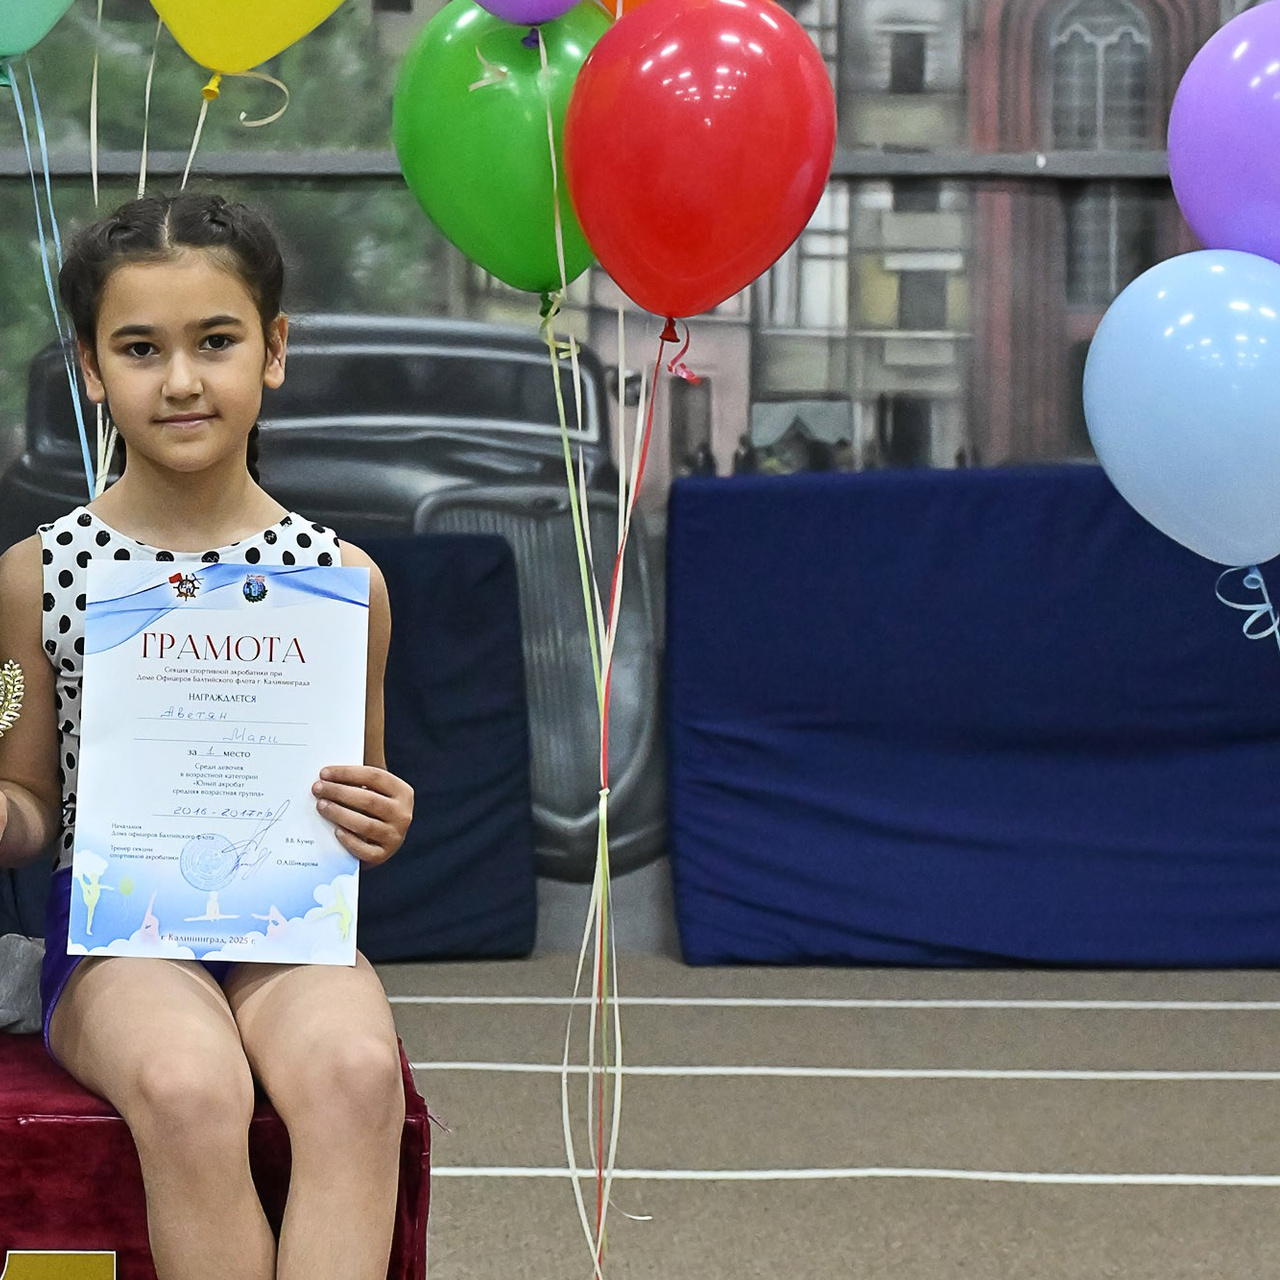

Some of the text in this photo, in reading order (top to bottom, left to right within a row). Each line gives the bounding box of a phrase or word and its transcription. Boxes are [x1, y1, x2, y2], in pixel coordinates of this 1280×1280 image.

[141, 632, 307, 664] ГРАМОТА
[164, 666, 189, 674] Секция
[156, 674, 192, 683] Офицеров
[263, 679, 311, 687] Калининграда
[188, 693, 257, 703] НАГРАЖДАЕТСЯ
[206, 746, 215, 755] 1
[194, 762, 217, 771] Среди
[218, 780, 245, 788] акробат
[168, 933, 227, 944] Калининград,
[229, 936, 249, 944] 2025
